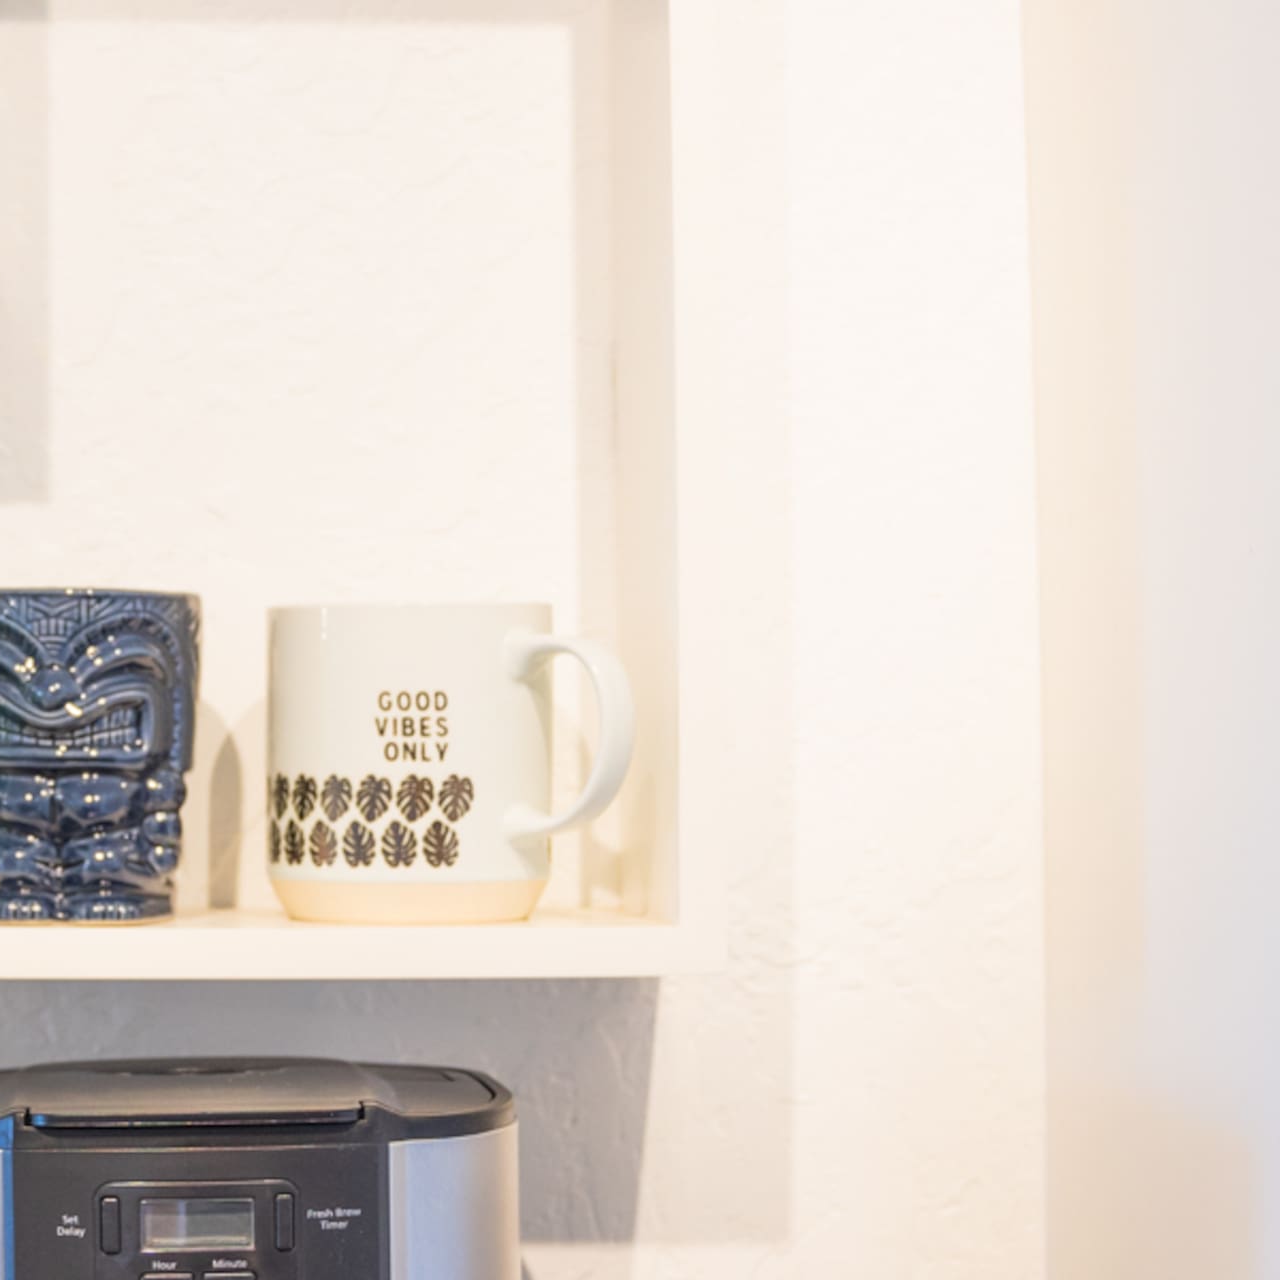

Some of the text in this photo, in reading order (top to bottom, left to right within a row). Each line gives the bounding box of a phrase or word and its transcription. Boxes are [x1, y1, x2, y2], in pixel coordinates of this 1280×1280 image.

[376, 690, 449, 712] GOOD
[374, 717, 449, 738] VIBES
[383, 741, 449, 763] ONLY
[306, 1207, 362, 1219] Fresh Brew
[62, 1214, 79, 1225] Set
[320, 1220, 349, 1231] Timer
[56, 1226, 86, 1239] Delay
[151, 1260, 177, 1270] Hour
[212, 1259, 248, 1269] Minute
